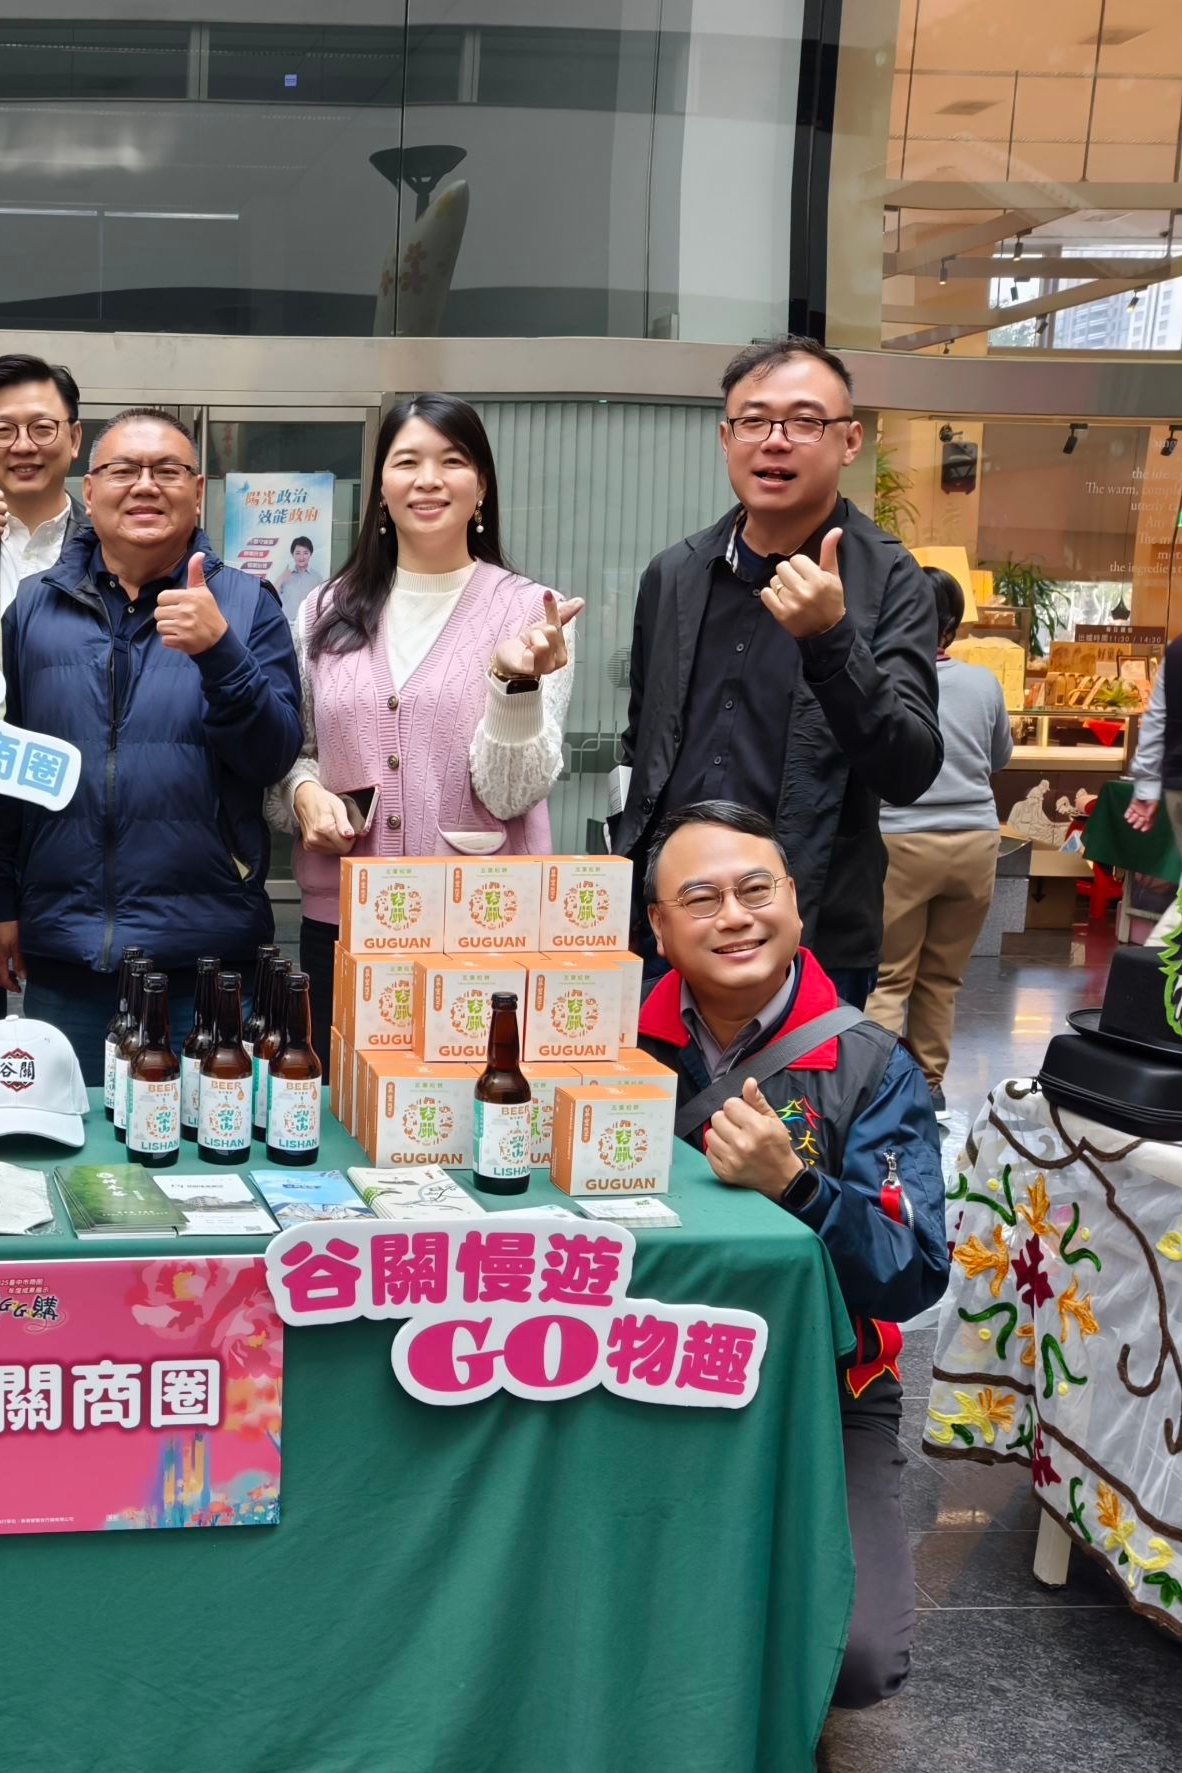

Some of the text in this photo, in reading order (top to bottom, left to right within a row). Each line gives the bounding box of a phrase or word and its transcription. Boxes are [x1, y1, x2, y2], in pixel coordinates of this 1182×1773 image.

[1086, 481, 1105, 495] The
[1108, 485, 1139, 496] warm,
[245, 488, 308, 506] 陽光政治
[258, 506, 319, 524] 效能政府
[364, 937, 431, 949] GUGUAN
[458, 937, 526, 948] GUGUAN
[552, 935, 617, 947] GUGUAN
[368, 1034, 413, 1045] GUGU
[439, 1046, 487, 1057] GUGU
[539, 1044, 607, 1056] GUGUAN
[148, 1083, 176, 1093] BEER
[211, 1080, 242, 1090] BEER
[286, 1081, 316, 1091] BEER
[141, 1138, 179, 1150] LISHAN
[204, 1136, 245, 1148] LISHAN
[278, 1137, 318, 1148] LISHAN
[390, 1153, 463, 1165] GUGUAN
[585, 1177, 656, 1190] GUGUAN
[280, 1230, 624, 1313] 谷關慢遊
